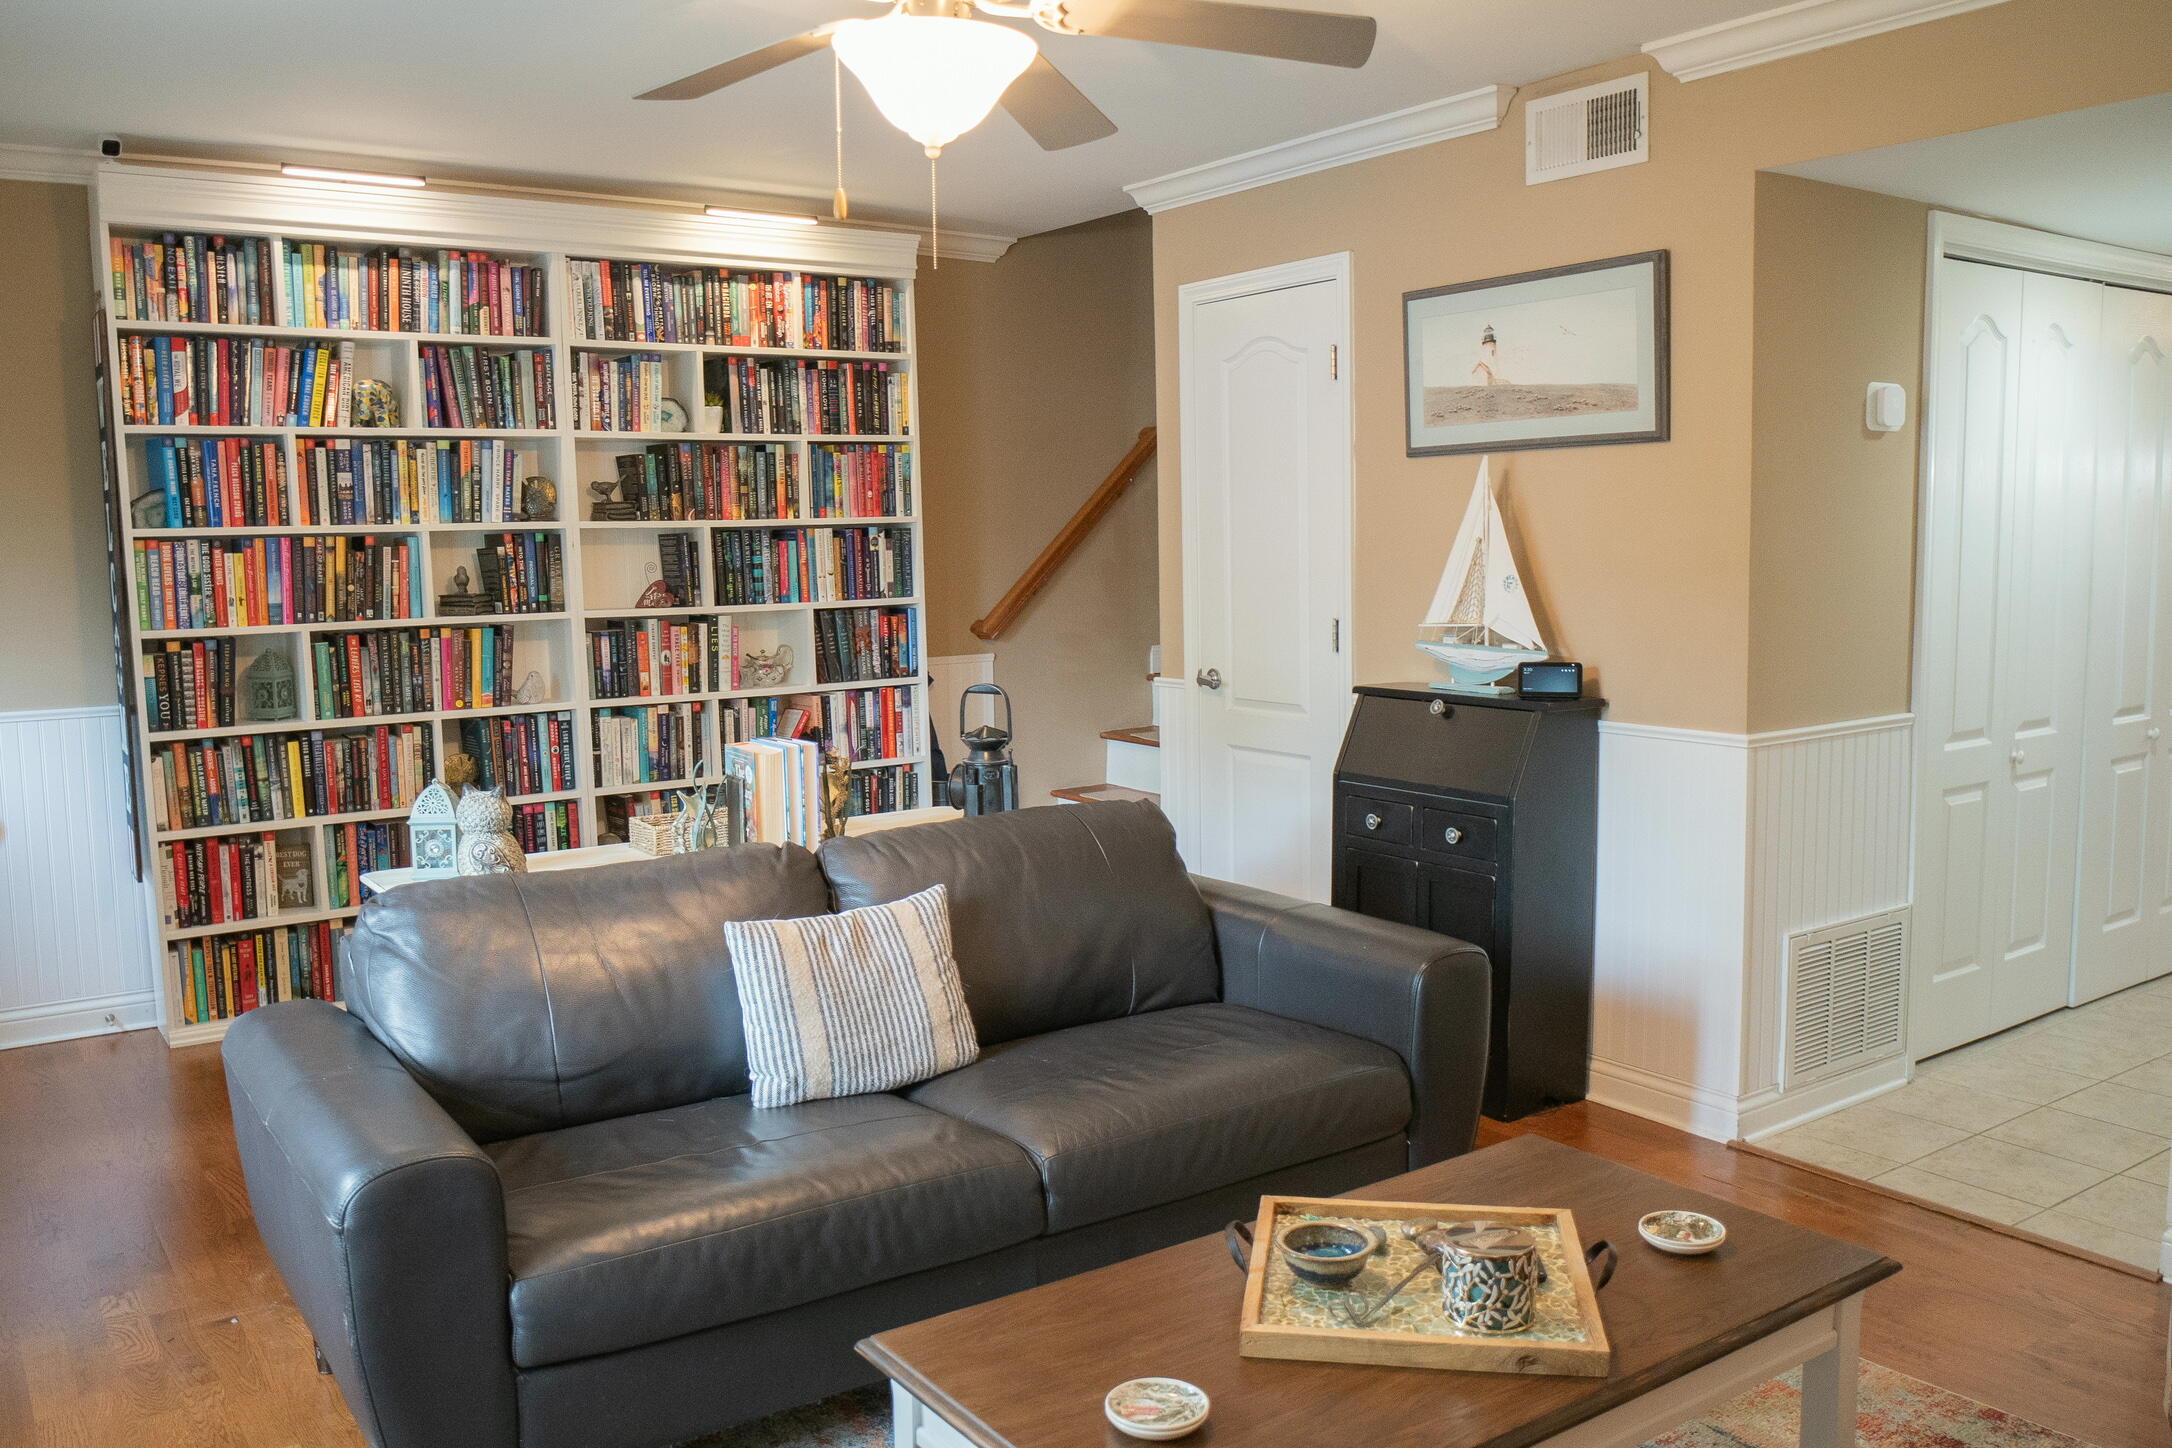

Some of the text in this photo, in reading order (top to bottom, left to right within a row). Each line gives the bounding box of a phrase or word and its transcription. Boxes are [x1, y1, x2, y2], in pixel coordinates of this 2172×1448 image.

[168, 248, 177, 290] NO EXIT
[402, 270, 412, 322] NINTH HOUSE
[482, 352, 490, 376] FIRST
[150, 555, 158, 577] BEACH
[162, 545, 172, 586] BOOK LOVERS
[202, 556, 210, 572] GOOD
[203, 574, 212, 596] SISTER
[711, 626, 719, 652] LIES
[350, 647, 360, 673] LEAVERS
[160, 693, 170, 720] YOU
